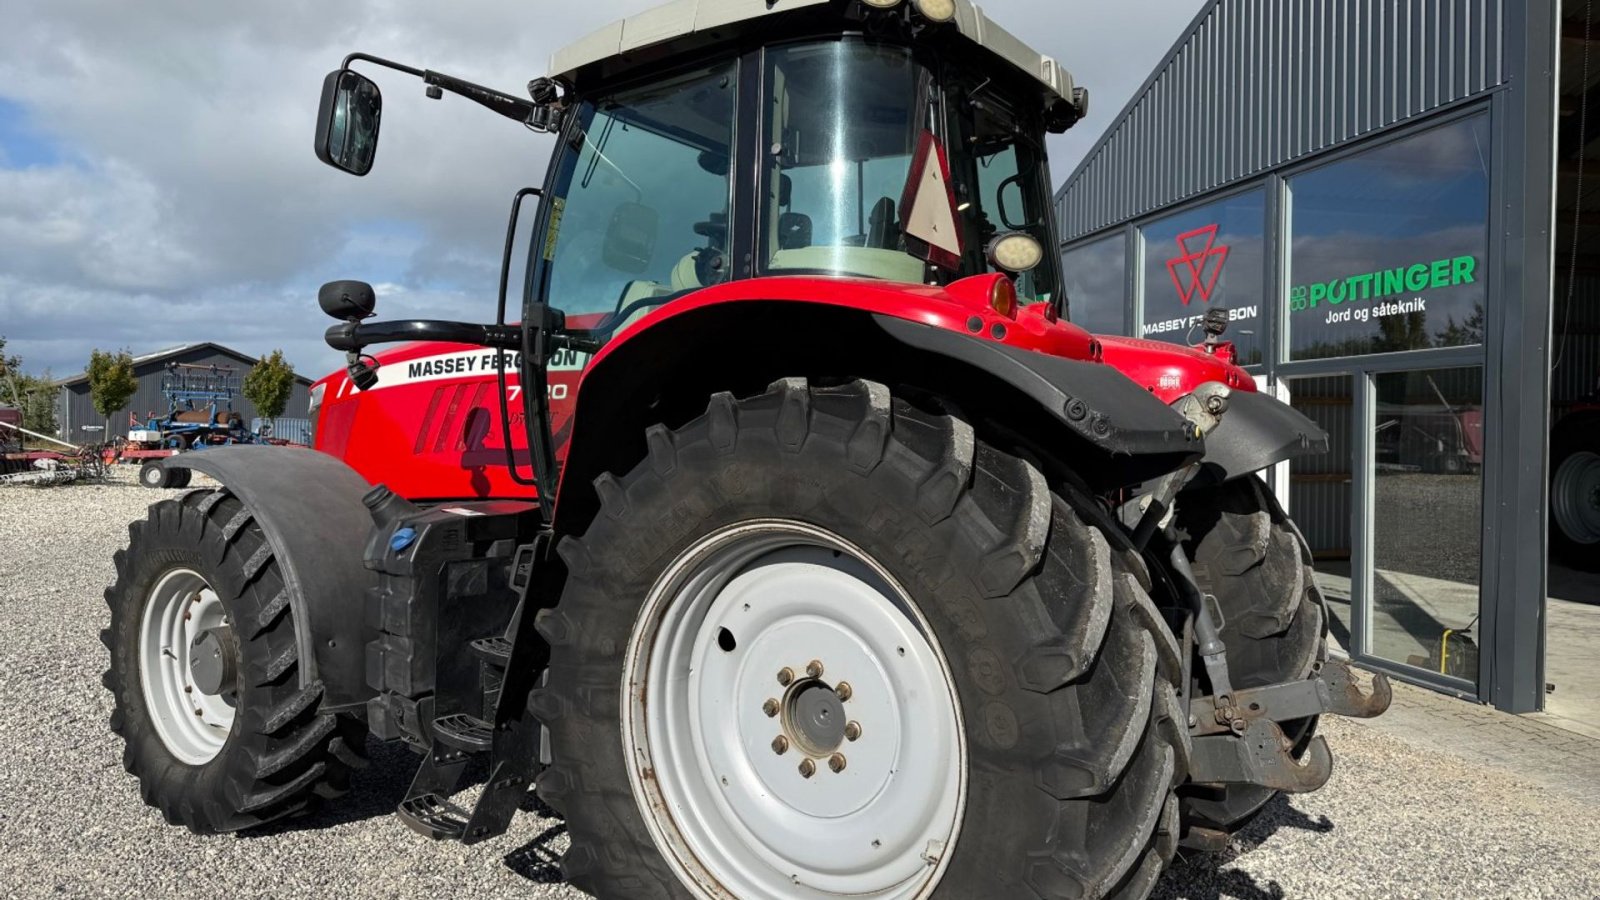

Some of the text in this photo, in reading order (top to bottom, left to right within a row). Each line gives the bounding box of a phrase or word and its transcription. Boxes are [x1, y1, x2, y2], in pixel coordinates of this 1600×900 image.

[1325, 297, 1426, 325] Jord og såteknik
[1142, 317, 1188, 336] MASSEY
[408, 350, 577, 378] MASSEY FERGON
[507, 384, 568, 401] 70
